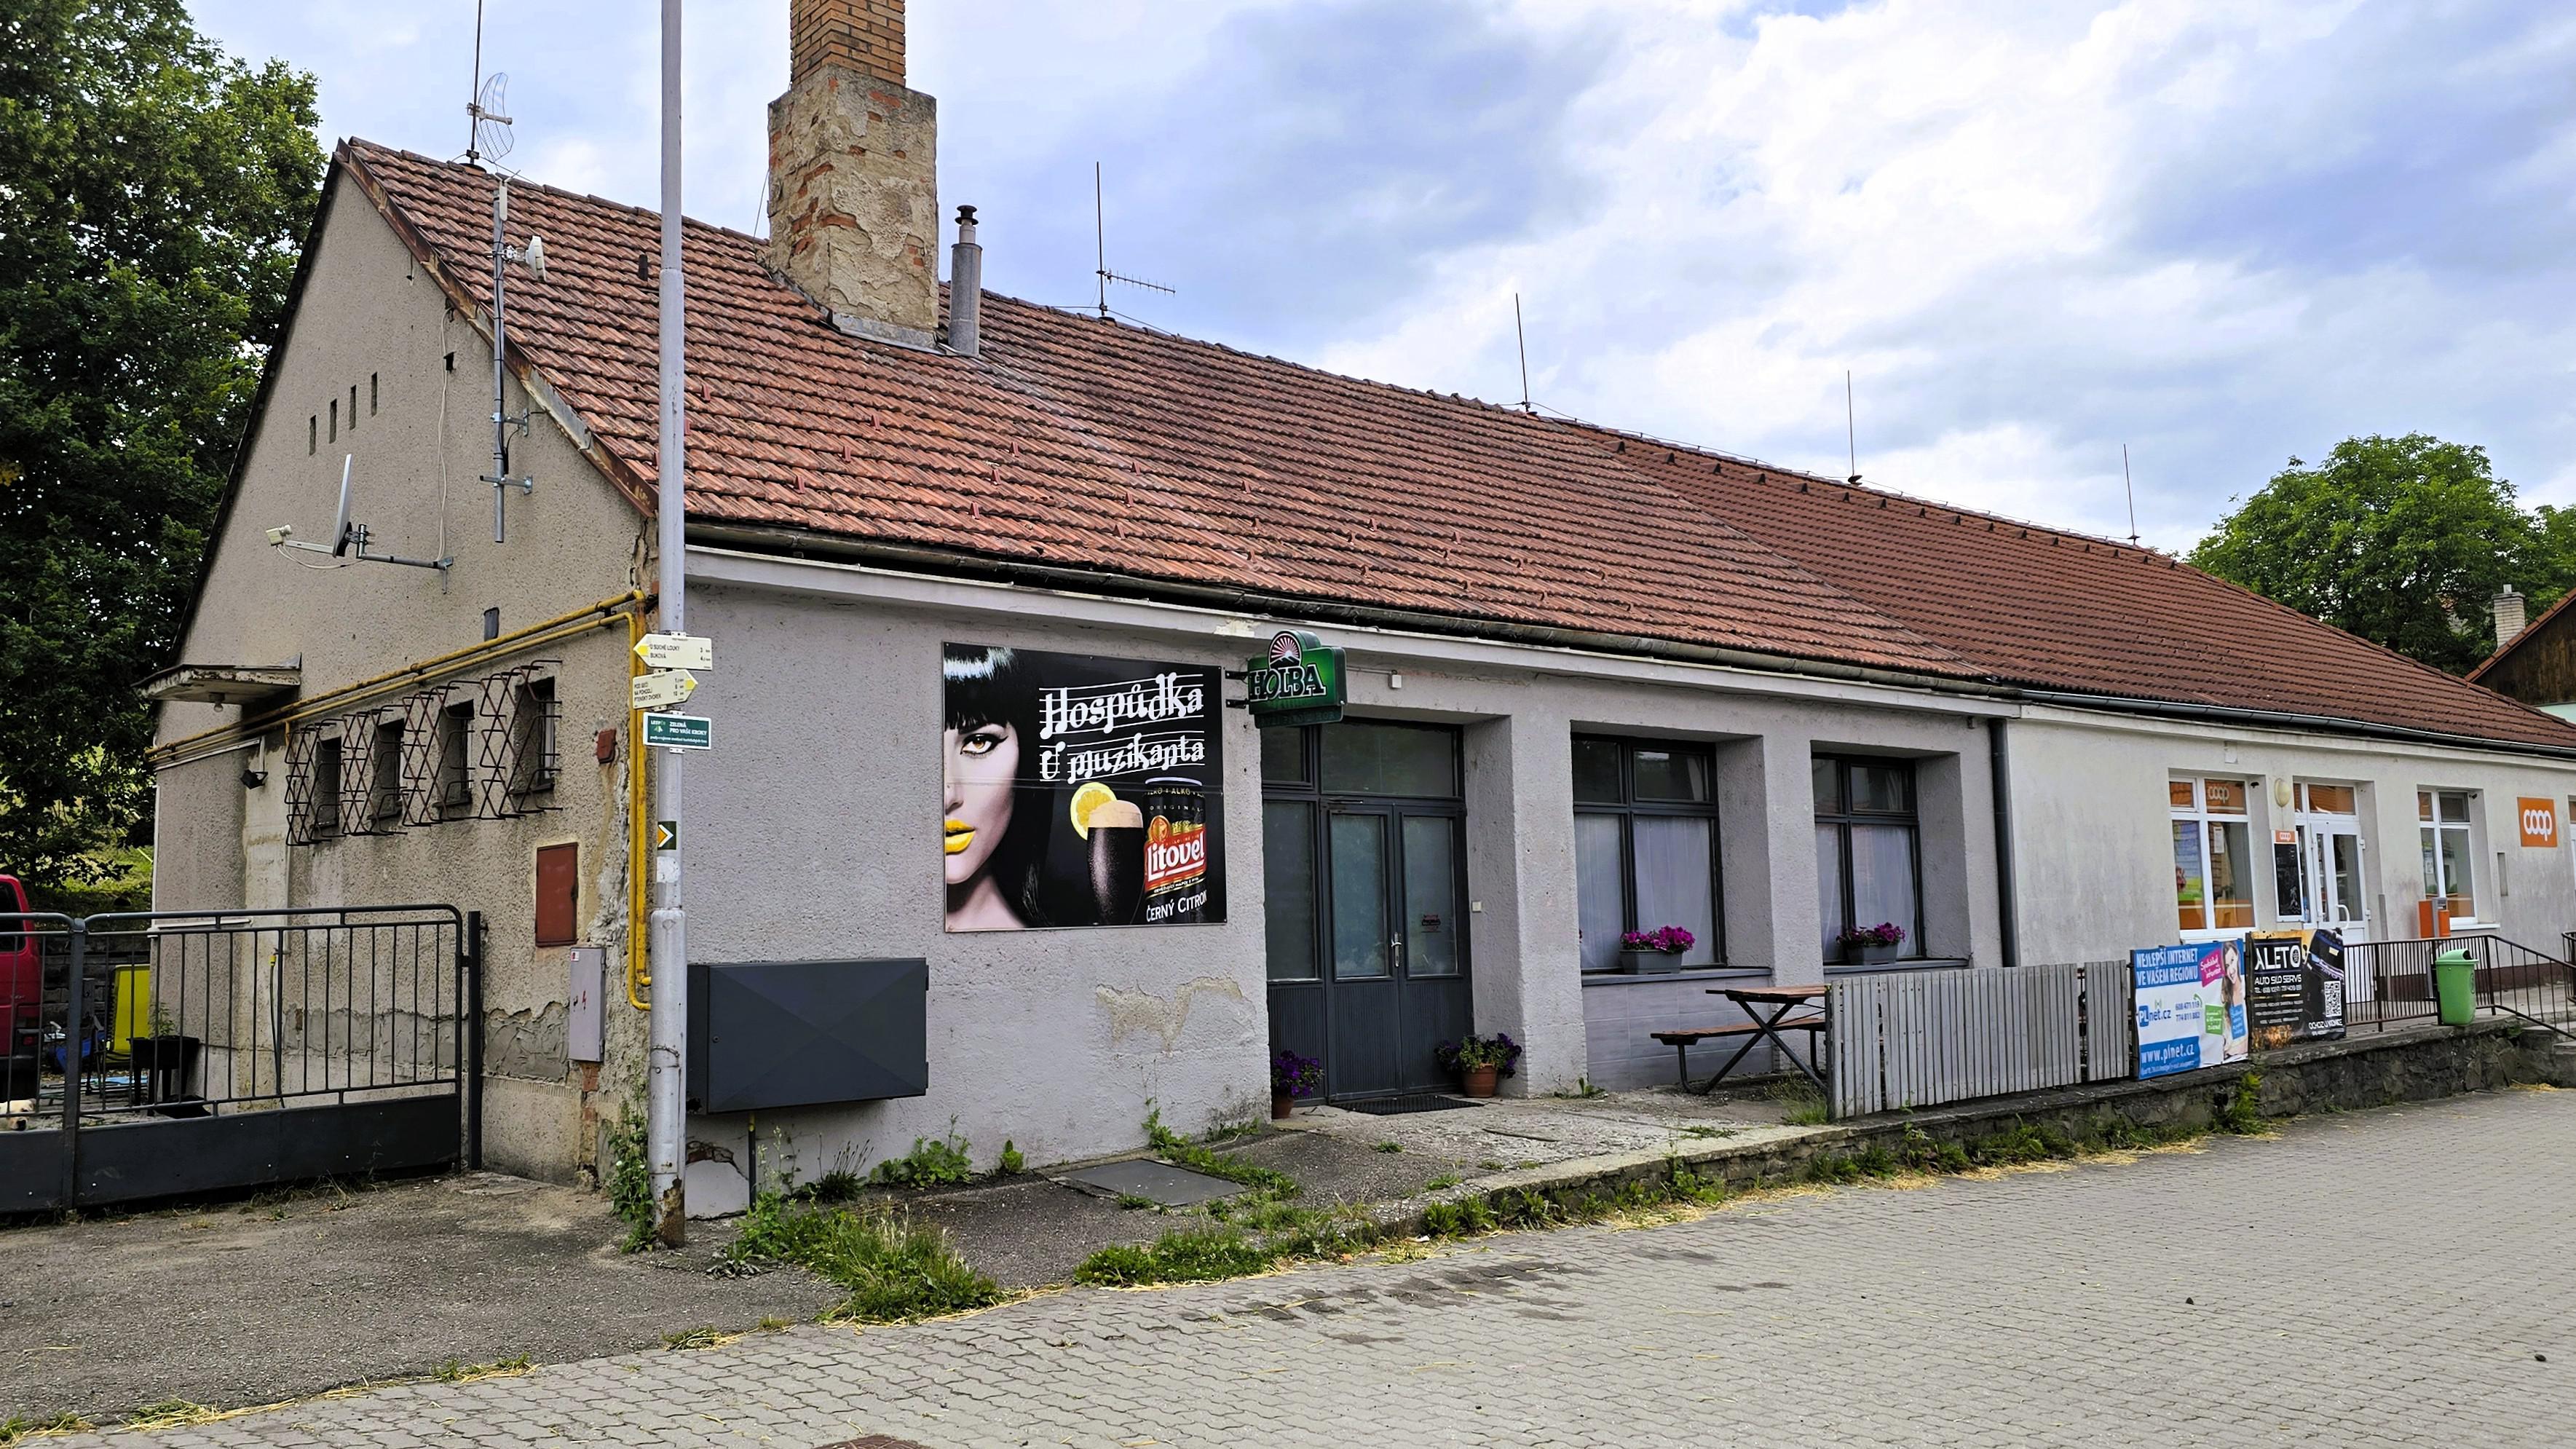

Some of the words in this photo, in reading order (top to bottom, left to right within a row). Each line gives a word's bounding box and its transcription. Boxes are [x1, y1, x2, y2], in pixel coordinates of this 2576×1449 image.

[1249, 663, 1327, 703] HOLBA
[1039, 671, 1204, 740] Hospůdka
[1067, 733, 1205, 785] muzikanta
[2208, 786, 2229, 804] coop
[1150, 805, 1201, 813] ORIGINAL
[2523, 808, 2553, 842] coop
[1147, 830, 1205, 883] Litovel
[1146, 899, 1175, 923] ČERNÝ
[2136, 947, 2166, 968] NEJLEPŠÍ
[2167, 948, 2198, 965] INTERNET
[2136, 971, 2146, 986] VE
[2147, 966, 2169, 984] VAŠEM
[2170, 965, 2198, 982] REGIONU
[2254, 976, 2270, 985] AUTO
[2283, 974, 2302, 984] SERVIS
[2141, 1043, 2195, 1064] www.plnet.cz
